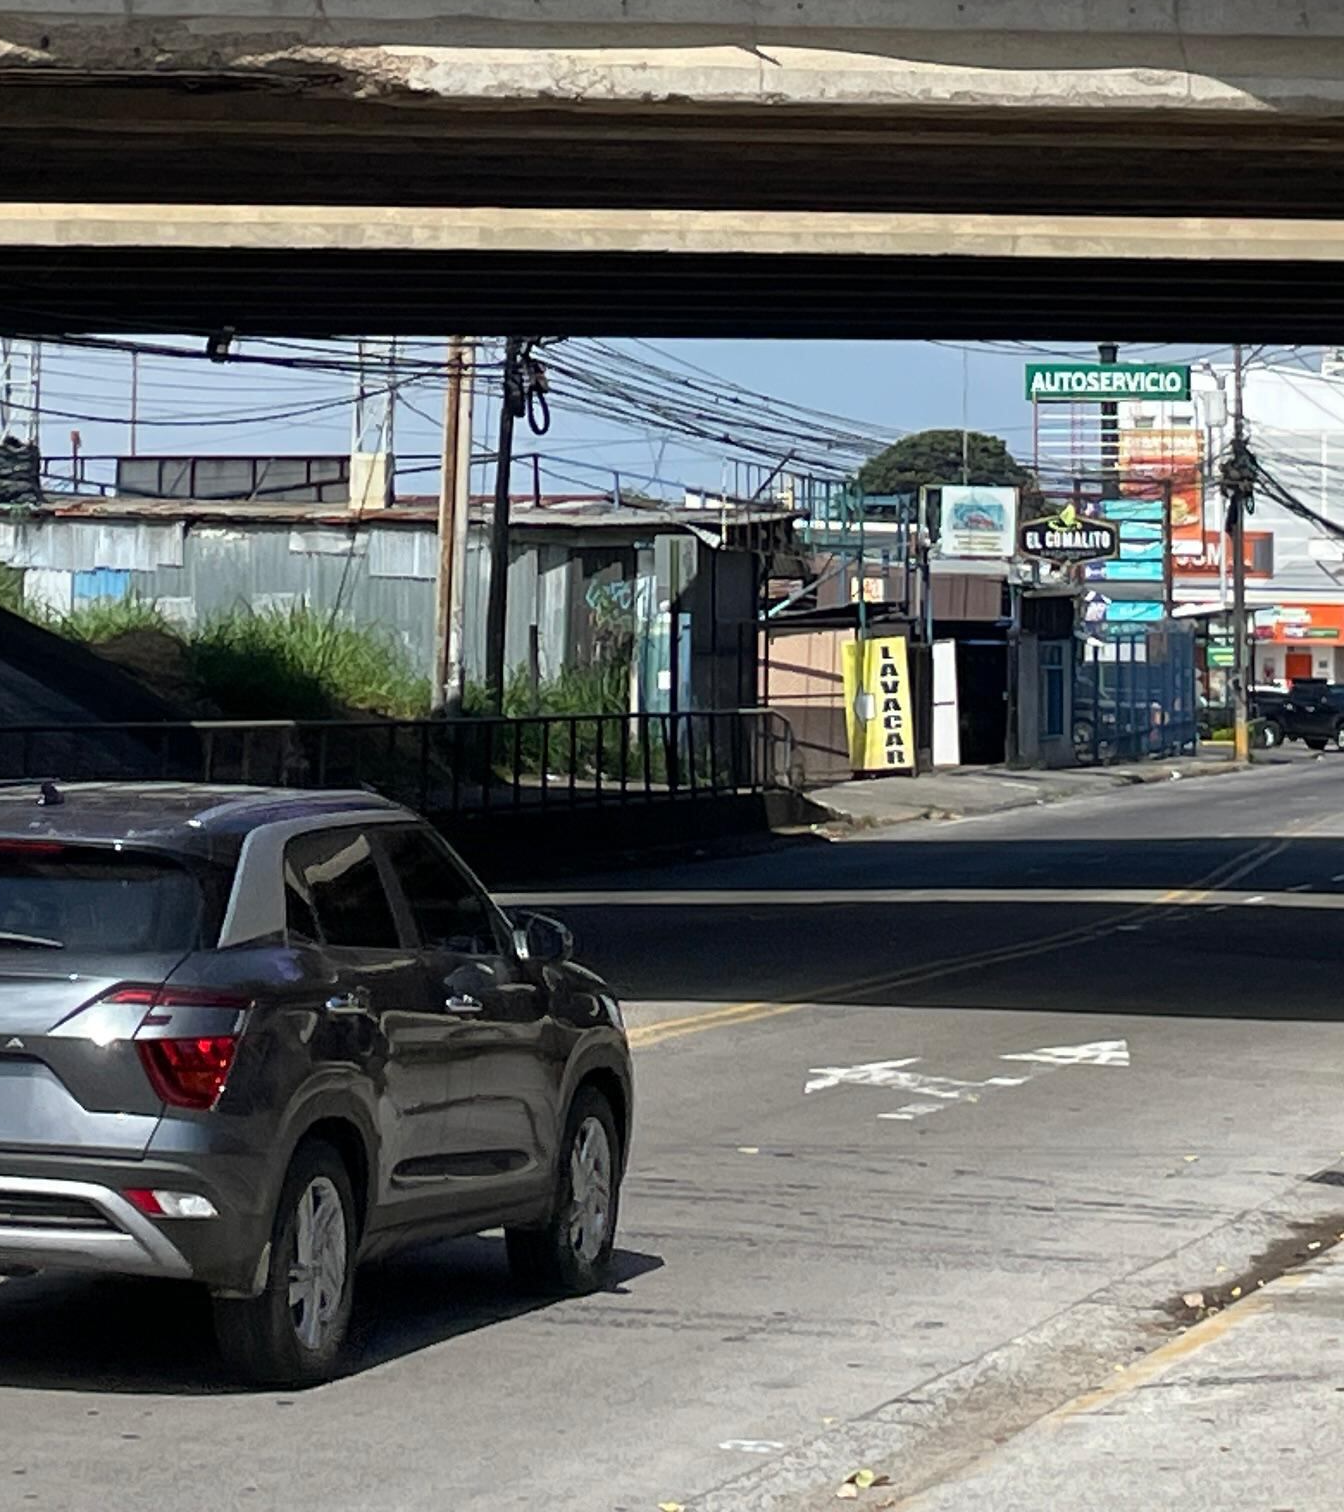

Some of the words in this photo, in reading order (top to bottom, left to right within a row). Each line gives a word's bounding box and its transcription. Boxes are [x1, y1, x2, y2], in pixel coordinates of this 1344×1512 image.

[1031, 371, 1182, 392] AUTOSERVICIO
[1025, 531, 1042, 550] EL
[1044, 530, 1111, 549] COMALITO
[880, 646, 905, 764] LAVACAR
